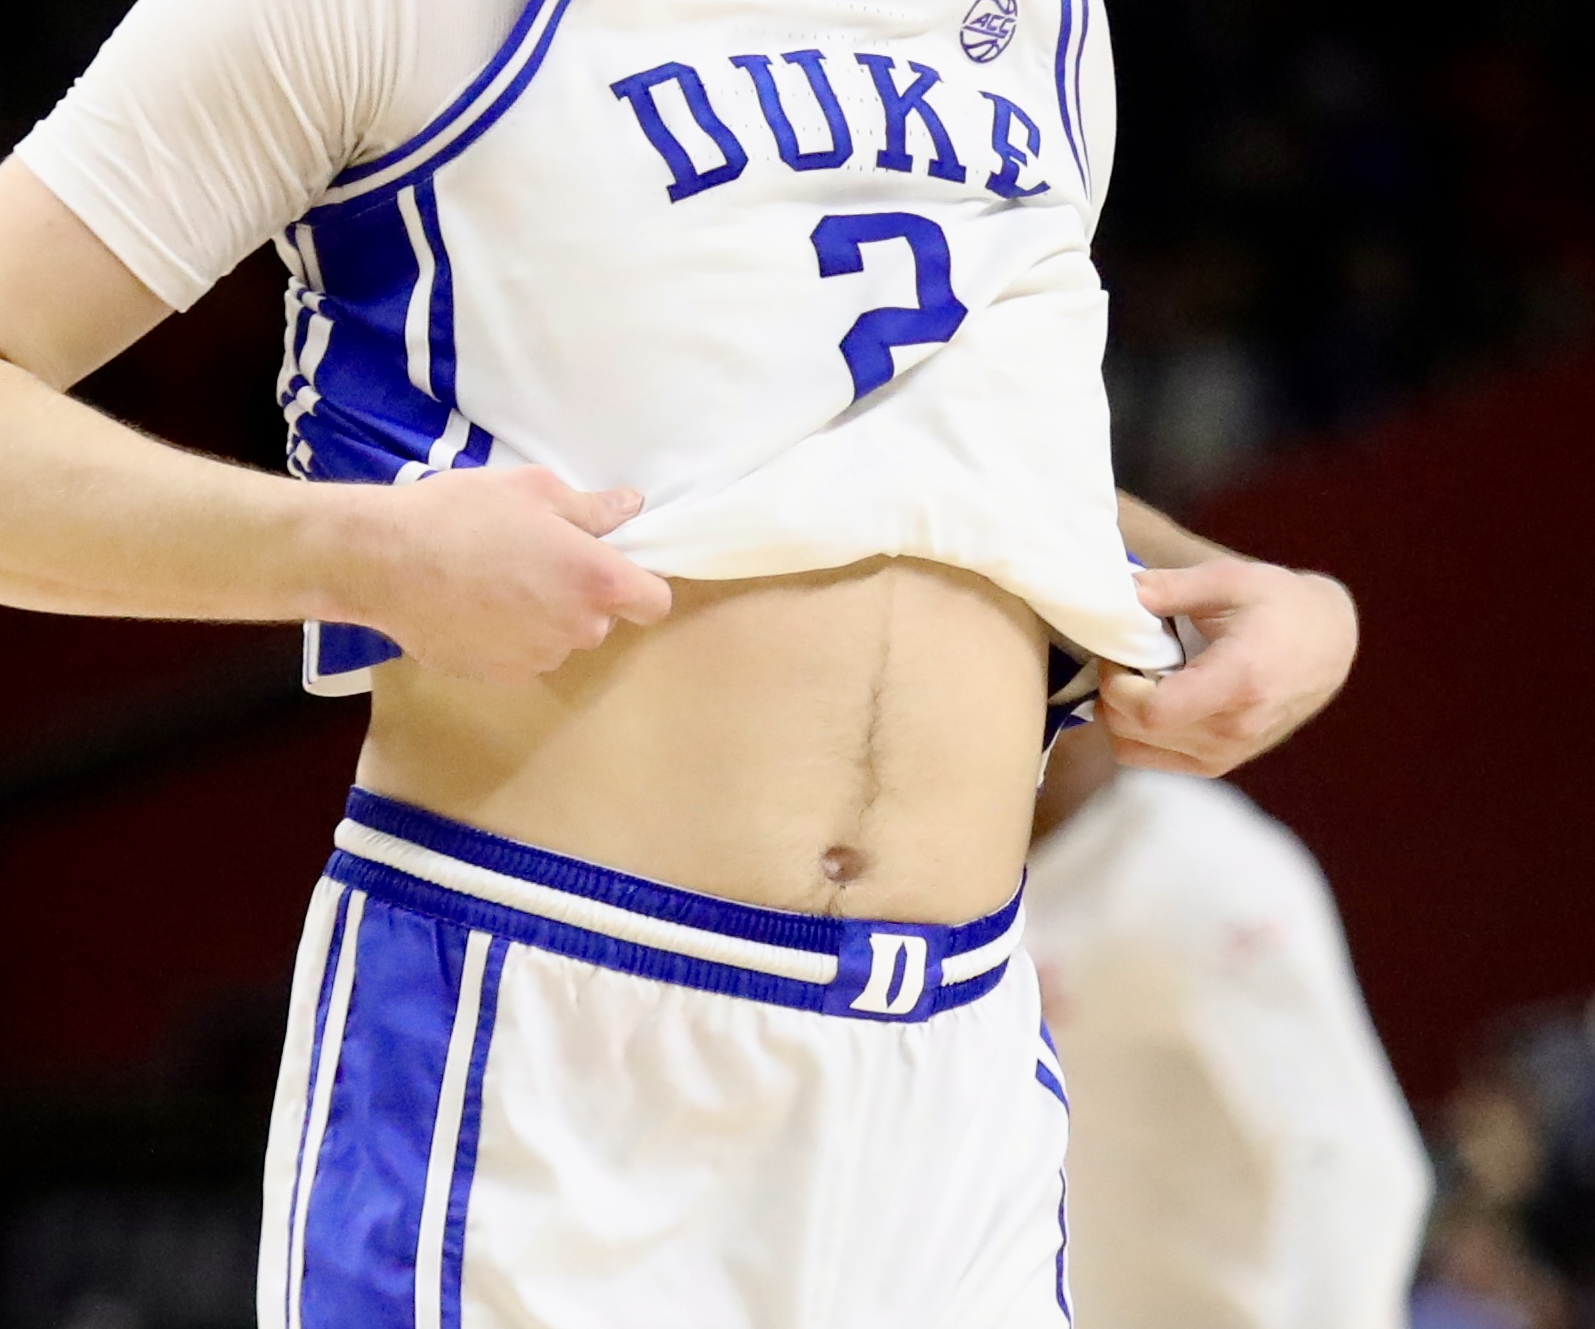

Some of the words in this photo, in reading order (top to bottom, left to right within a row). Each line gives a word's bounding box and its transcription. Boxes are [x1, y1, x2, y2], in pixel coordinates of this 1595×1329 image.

[969, 12, 1016, 35] ACC
[610, 49, 1051, 204] DUKE
[810, 211, 969, 406] 2
[849, 933, 928, 1015] D
